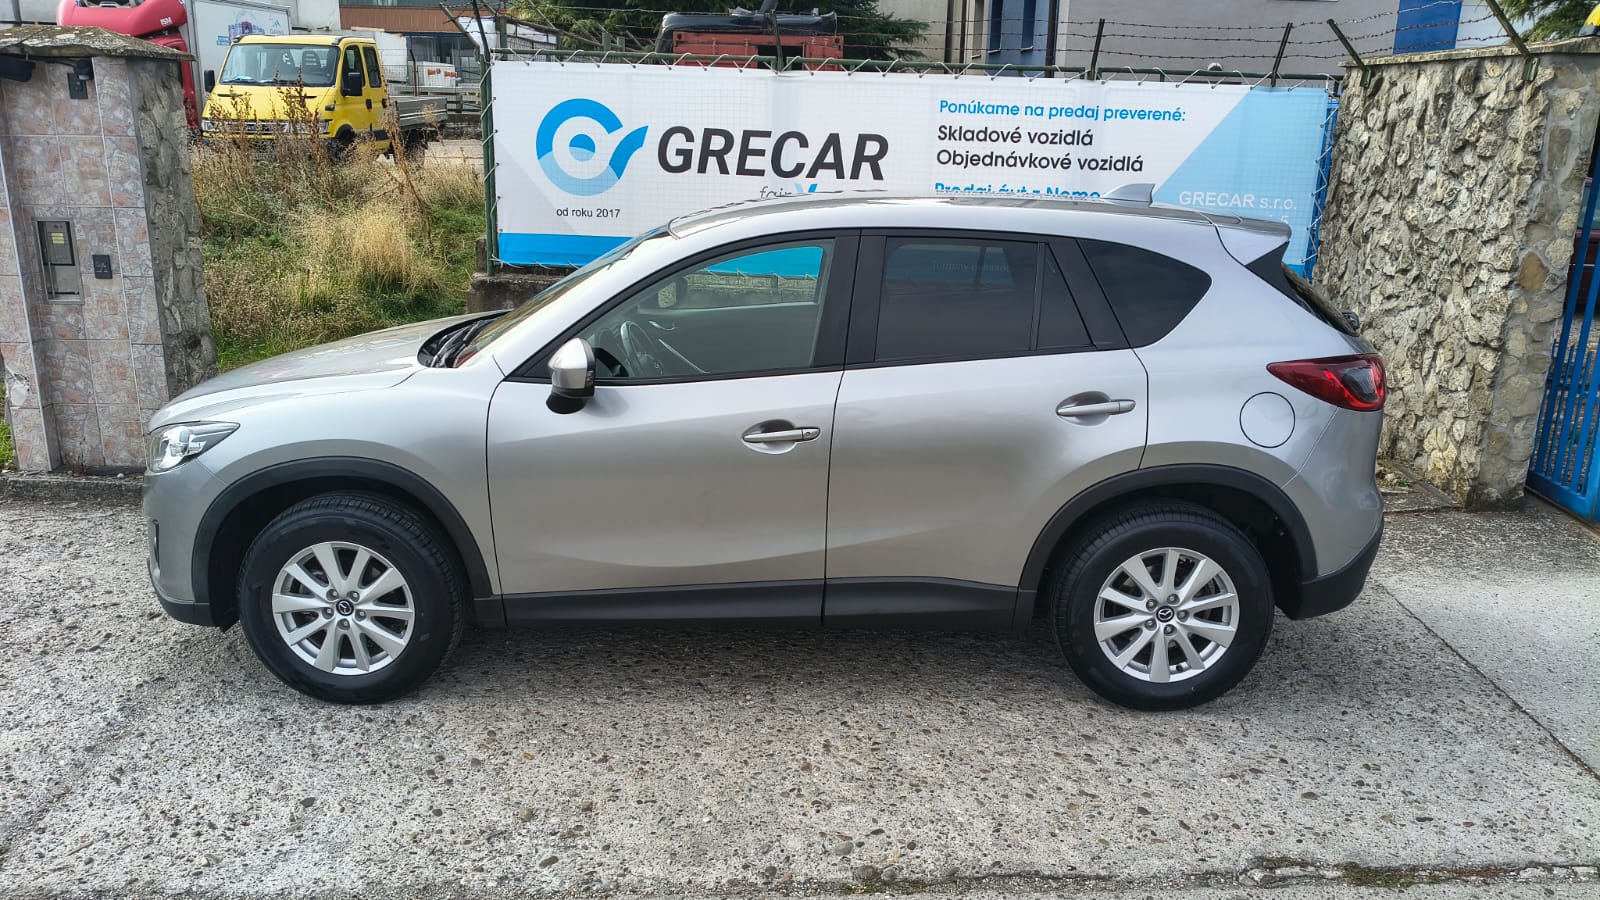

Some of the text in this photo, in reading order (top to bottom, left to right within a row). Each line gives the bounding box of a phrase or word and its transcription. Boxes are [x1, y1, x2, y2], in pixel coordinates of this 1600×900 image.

[940, 99, 1186, 121] Ponúkame na predaj preverené:
[937, 125, 1094, 146] Skladové vozidlá
[657, 125, 889, 182] GRECAR
[936, 149, 1144, 172] Objednávkové vozidlá
[1179, 191, 1297, 210] GRECAR s.r.o.
[556, 207, 621, 219] od roku 2017
